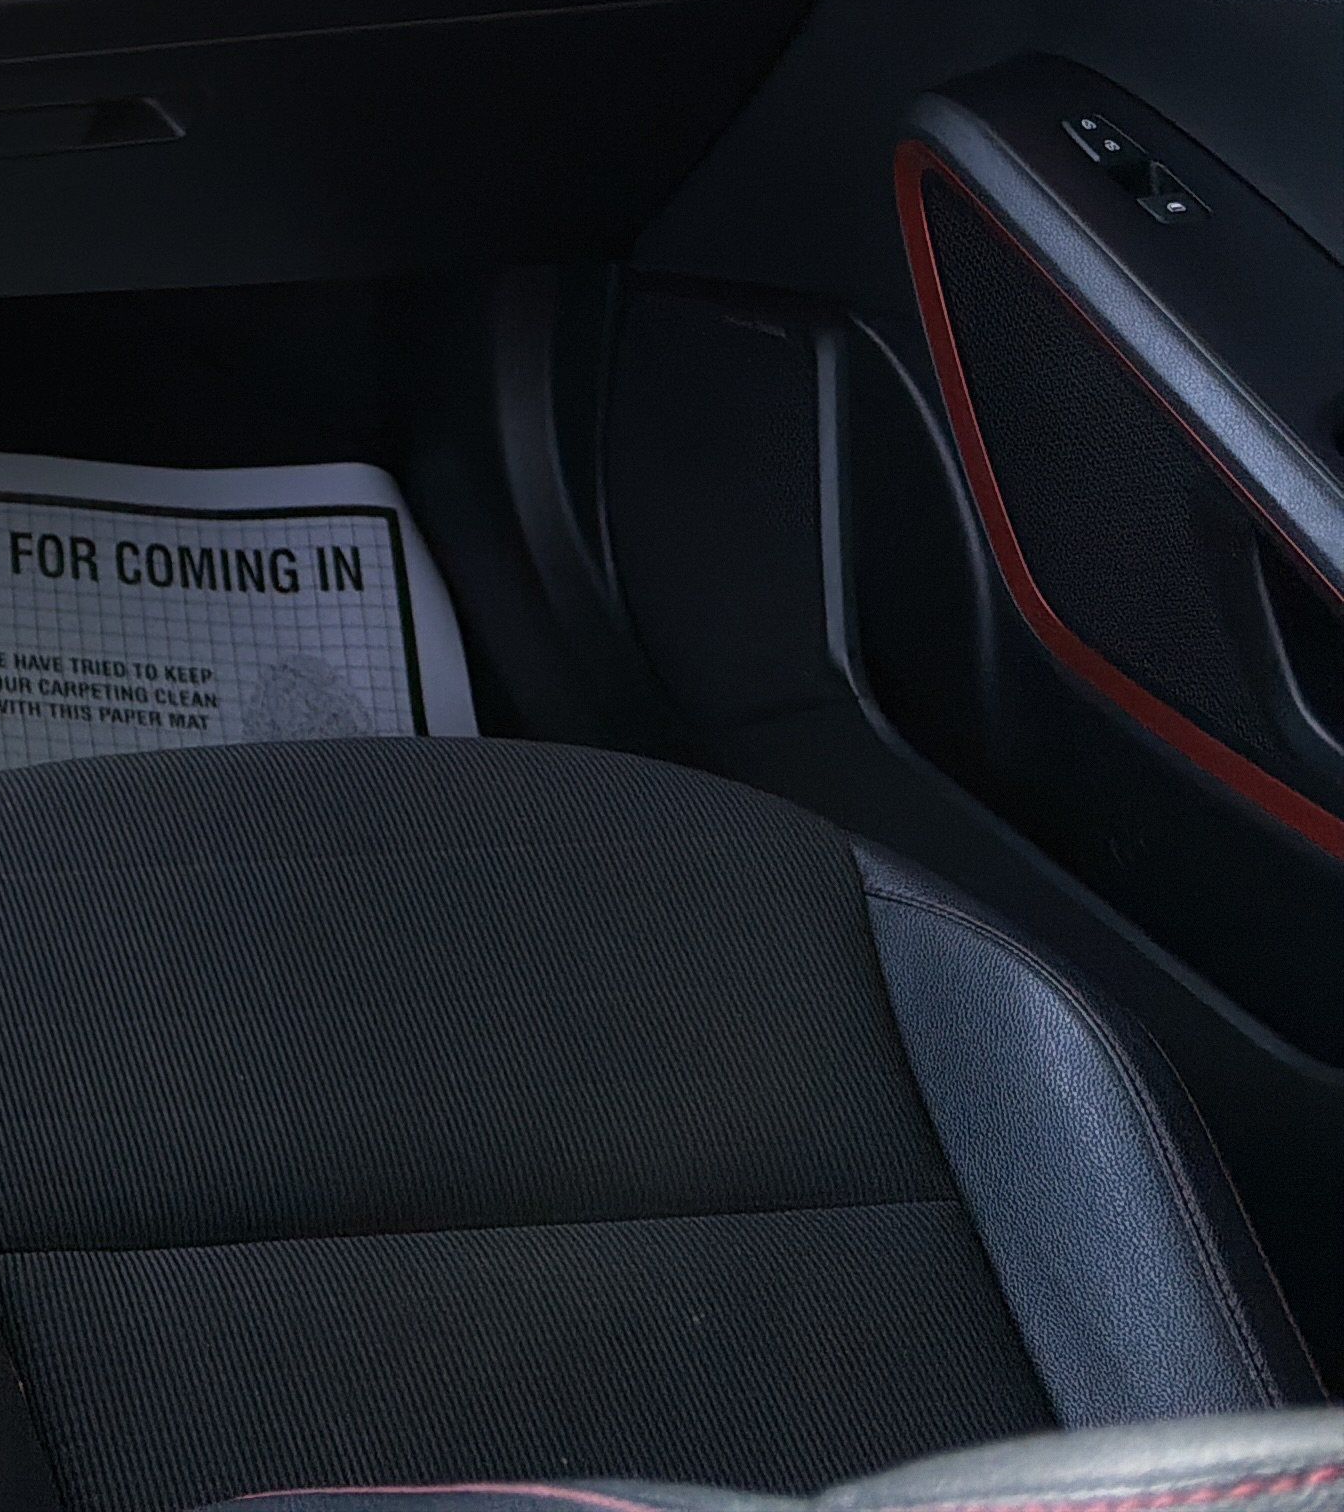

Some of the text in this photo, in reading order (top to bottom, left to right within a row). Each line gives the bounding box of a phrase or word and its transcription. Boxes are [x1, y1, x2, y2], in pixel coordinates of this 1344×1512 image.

[11, 532, 100, 582] FOR
[116, 541, 300, 595] COMING
[317, 546, 366, 594] IN
[13, 655, 63, 673] HAVE
[69, 657, 127, 678] TRIED
[132, 662, 158, 681] TO
[164, 665, 213, 684] KEEP
[38, 678, 149, 704] CARPETING
[155, 688, 218, 709] CLEAN
[49, 702, 92, 722] THIS
[99, 706, 162, 727] PAPER
[168, 713, 209, 731] MAT
